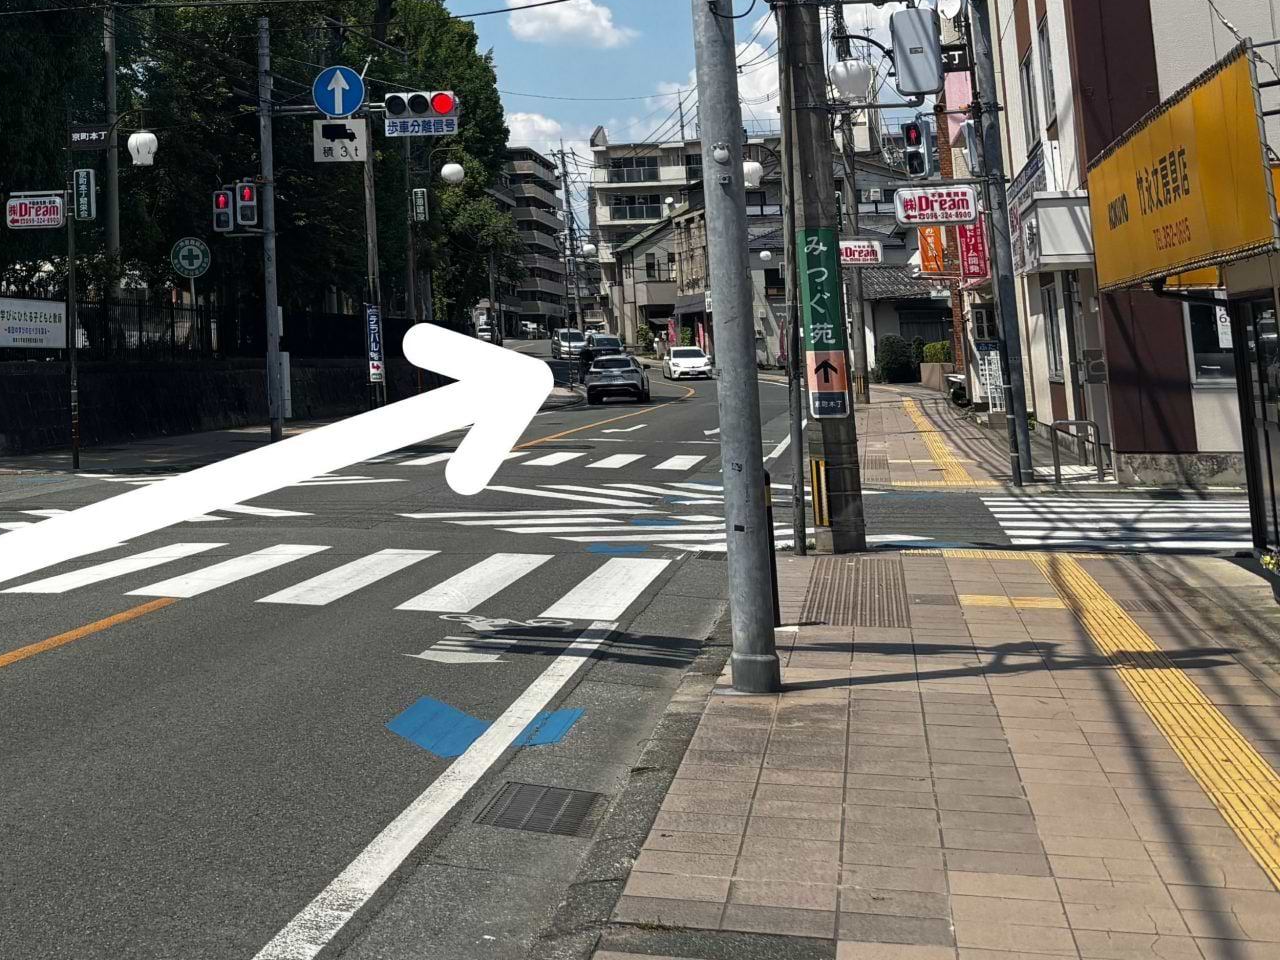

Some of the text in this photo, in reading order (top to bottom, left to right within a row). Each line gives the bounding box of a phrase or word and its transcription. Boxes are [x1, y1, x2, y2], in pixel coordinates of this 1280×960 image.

[387, 119, 456, 135] 歩車分離信号
[72, 131, 108, 142] 京町本丁
[323, 146, 359, 158] 積 3 t
[1136, 145, 1191, 217] 竹永文房具店
[19, 202, 59, 217] Dream
[918, 195, 970, 212] Dream
[844, 246, 878, 258] Dream
[804, 236, 836, 344] みつぐ苑
